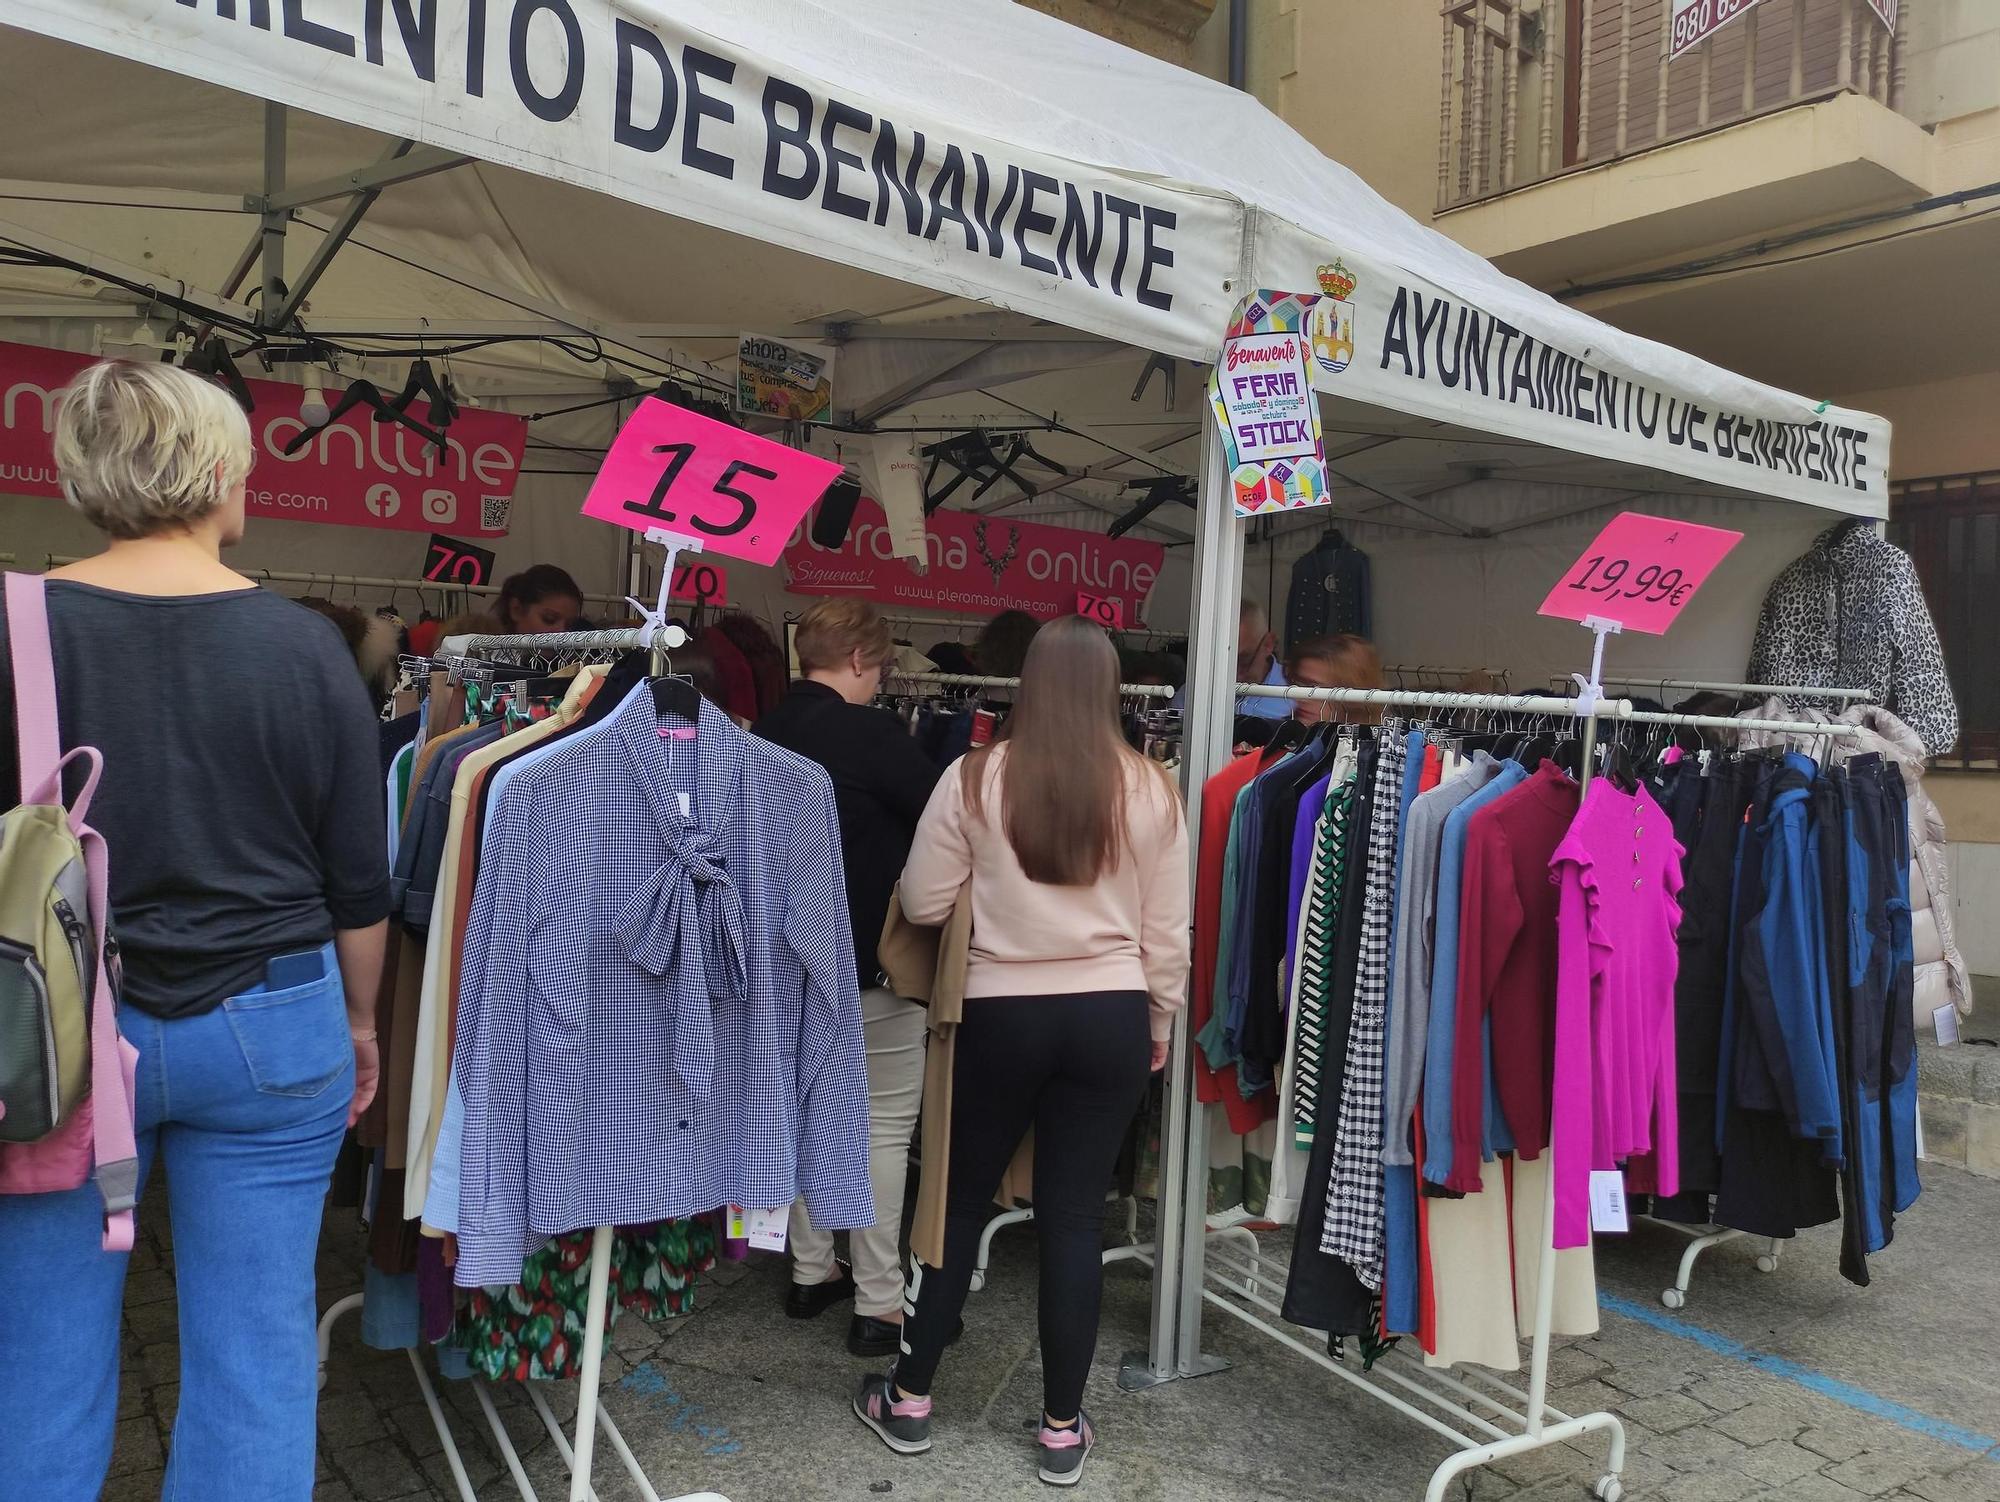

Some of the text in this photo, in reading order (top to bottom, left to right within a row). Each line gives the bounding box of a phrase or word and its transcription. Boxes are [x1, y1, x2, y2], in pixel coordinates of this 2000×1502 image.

[1675, 0, 1711, 49] 980
[614, 18, 737, 179] DE
[761, 76, 1177, 311] BENAVENTE
[741, 337, 787, 361] ahora
[1227, 338, 1296, 372] Benavente
[1232, 372, 1299, 400] FERIA
[1380, 286, 1868, 491] AYUNTAMIENTO DE BENAVENTE
[263, 410, 514, 486] online
[1238, 420, 1310, 448] STOCK
[622, 442, 778, 537] 15
[1665, 531, 1678, 544] A
[424, 544, 482, 588] 70
[1026, 541, 1157, 593] online
[1080, 594, 1114, 622] 70
